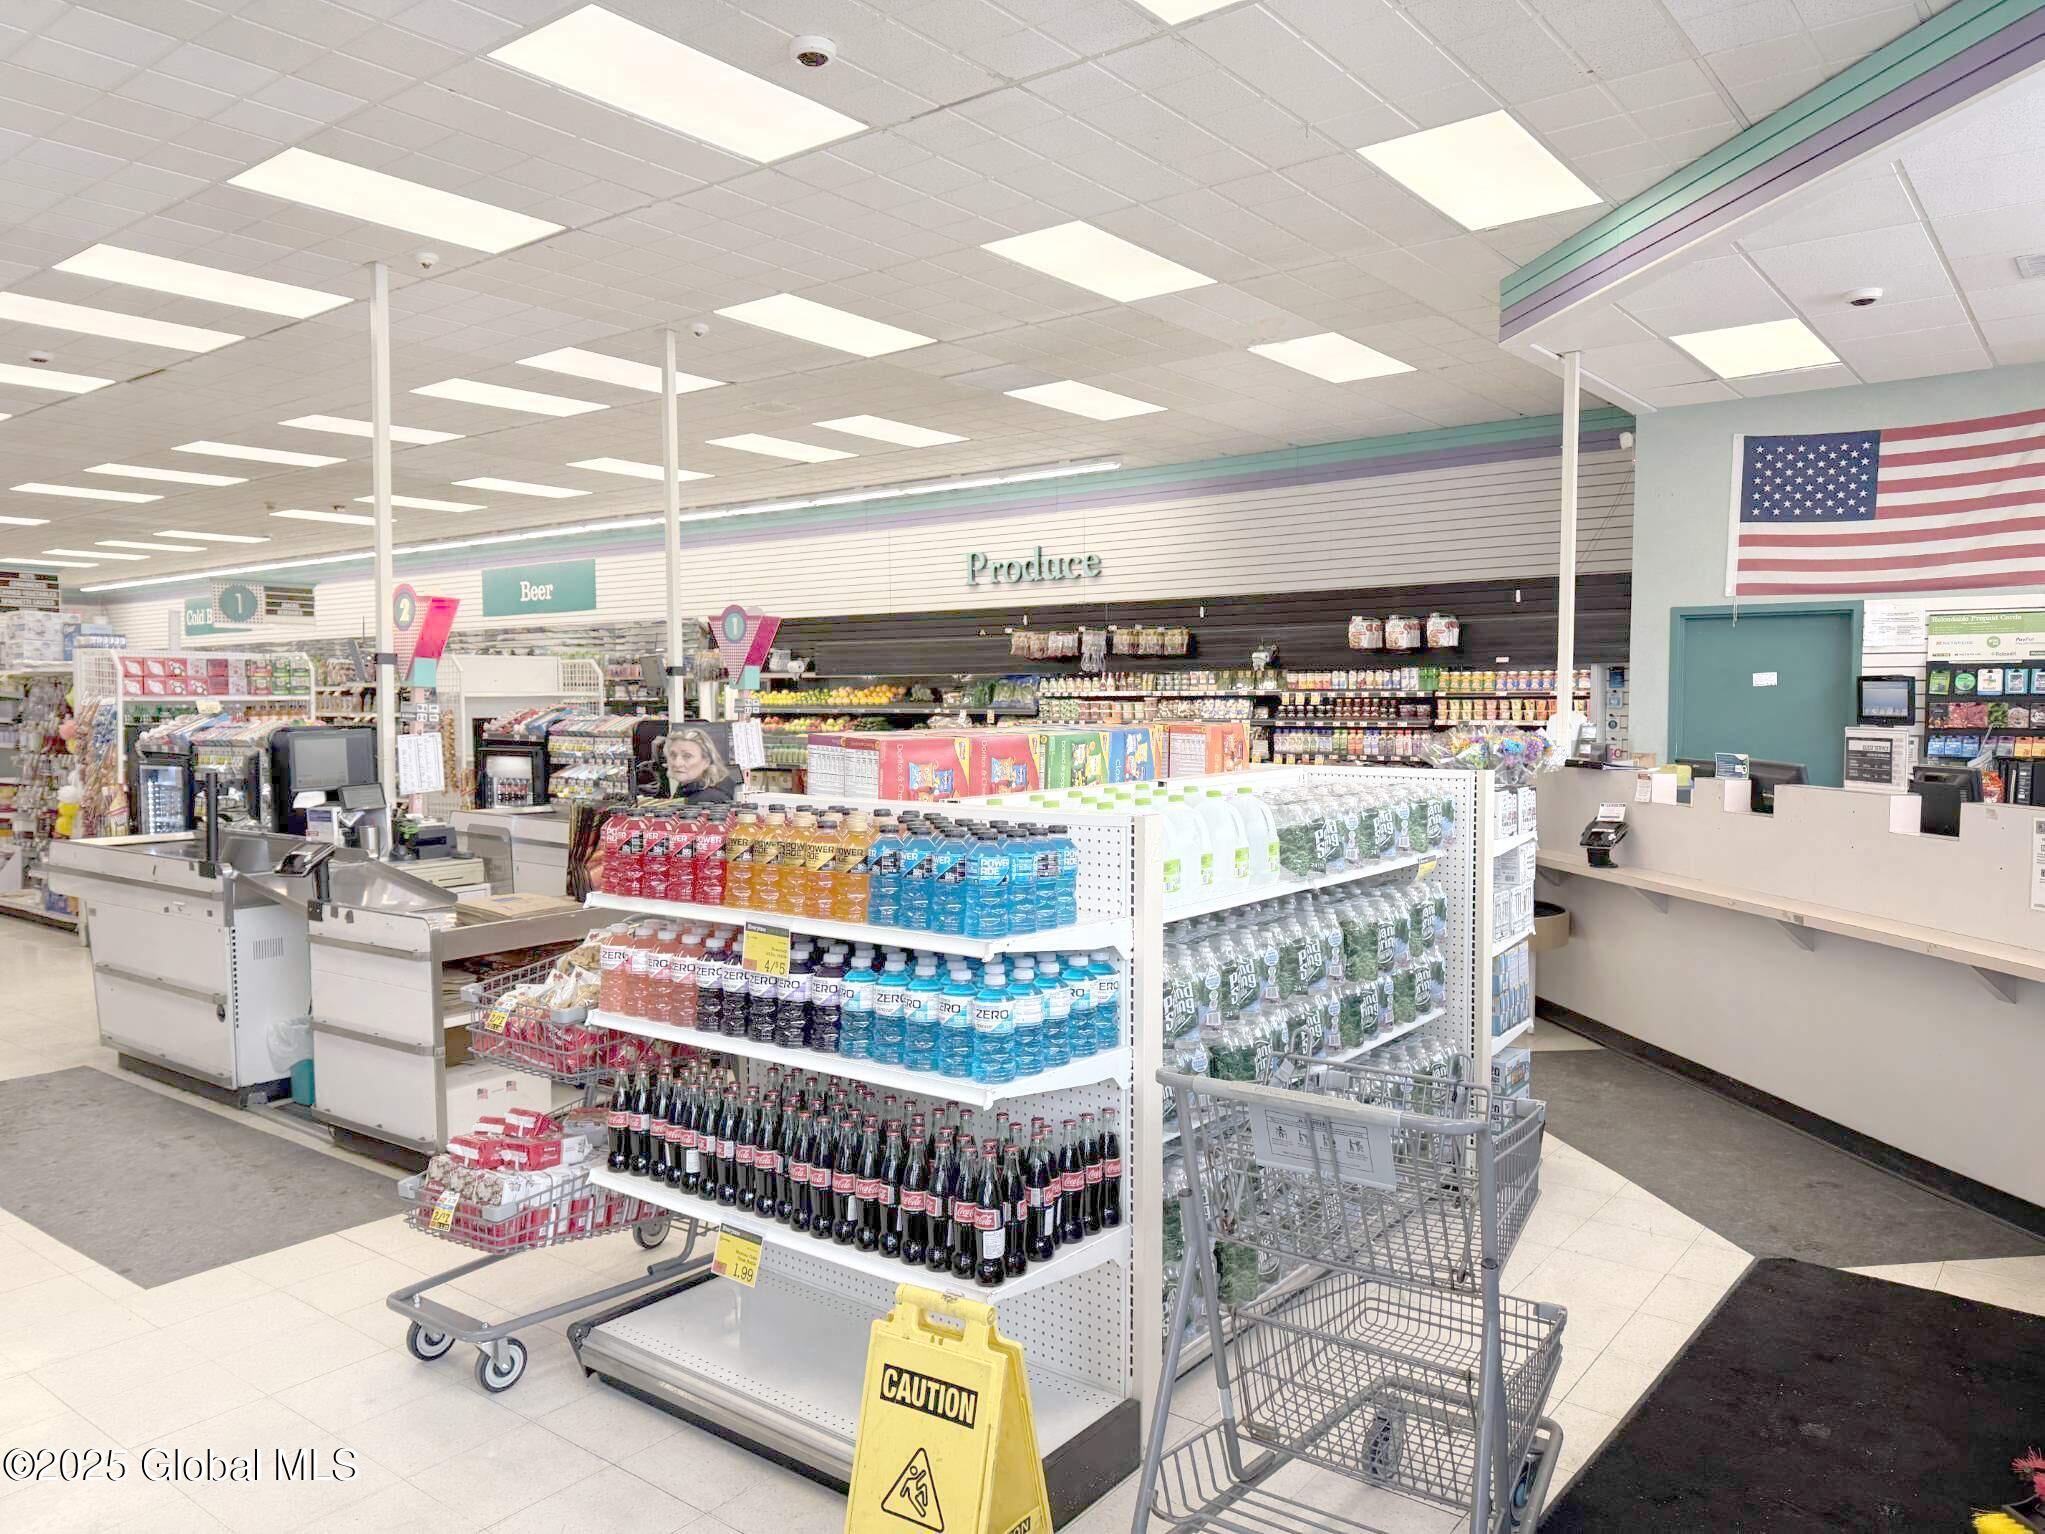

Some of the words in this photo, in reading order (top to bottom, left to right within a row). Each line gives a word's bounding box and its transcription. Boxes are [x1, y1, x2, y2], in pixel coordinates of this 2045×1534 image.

[965, 545, 1103, 587] Produce
[519, 580, 554, 602] Beer
[235, 593, 243, 614] 1
[399, 598, 411, 622] 2
[186, 608, 205, 625] Cold
[732, 615, 739, 636] 1
[671, 834, 688, 842] WER
[648, 958, 668, 968] ERO
[778, 978, 800, 989] ERO
[1099, 980, 1119, 991] ERO
[839, 988, 854, 999] RO
[1070, 988, 1085, 997] RO
[975, 1008, 1009, 1020] ZERO
[732, 1262, 754, 1282] 1.99
[882, 1367, 977, 1425] CAUTION
